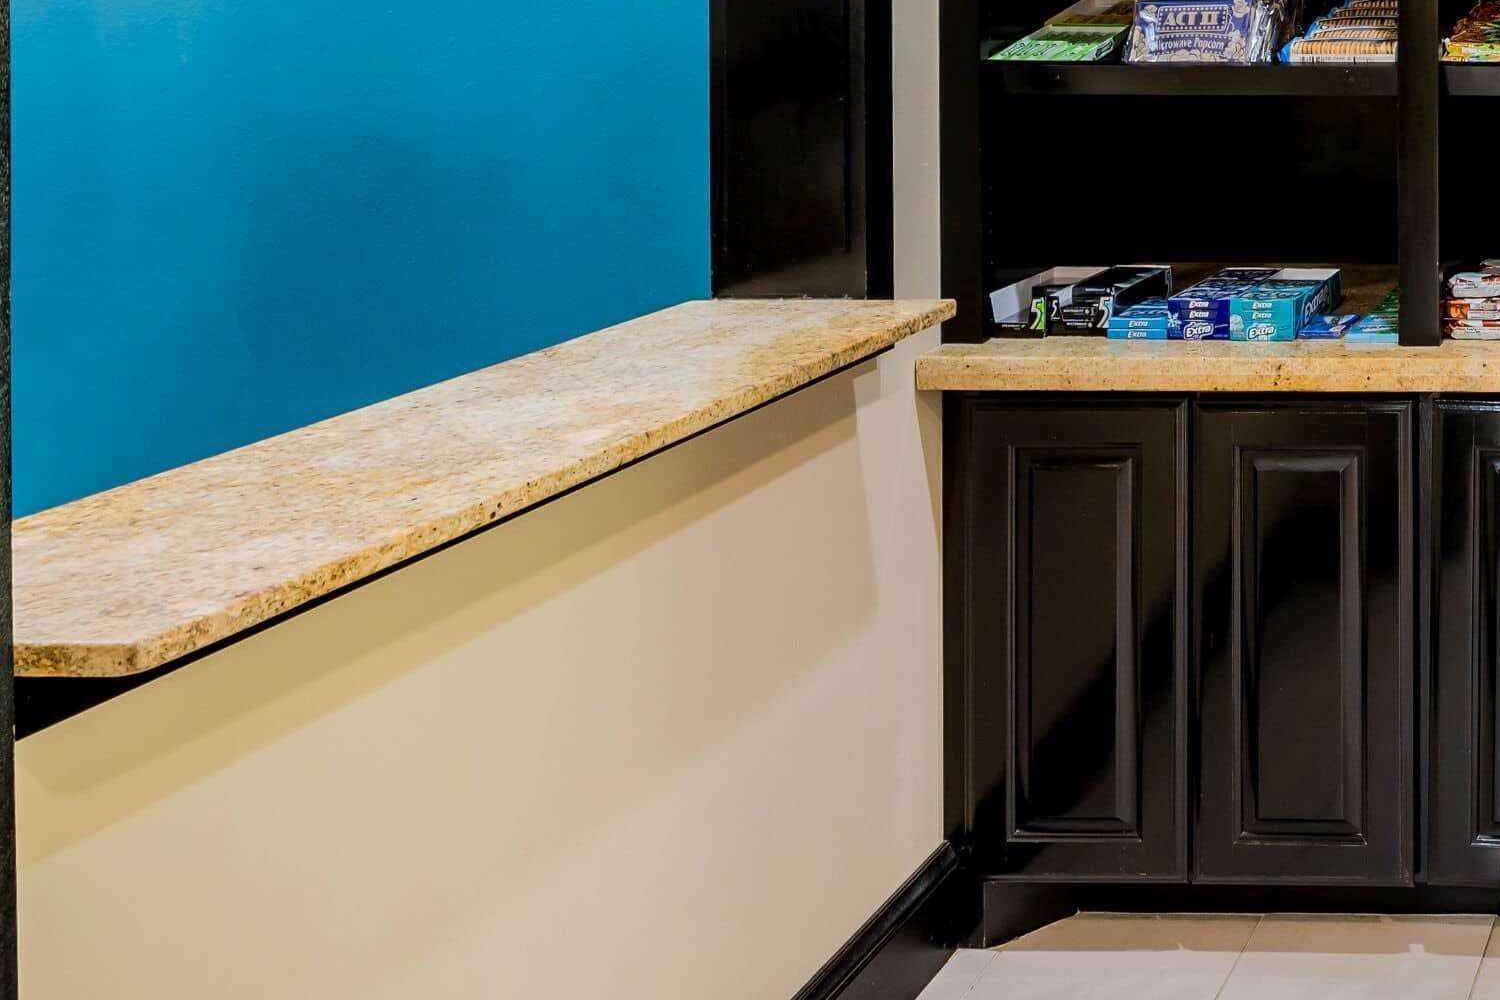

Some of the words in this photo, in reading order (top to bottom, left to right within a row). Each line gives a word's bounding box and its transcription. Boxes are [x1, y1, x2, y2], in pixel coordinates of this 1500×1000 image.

[1163, 11, 1197, 26] ACT
[1193, 36, 1225, 52] Popcorn
[1185, 324, 1212, 338] Extra
[1248, 325, 1275, 339] Extra
